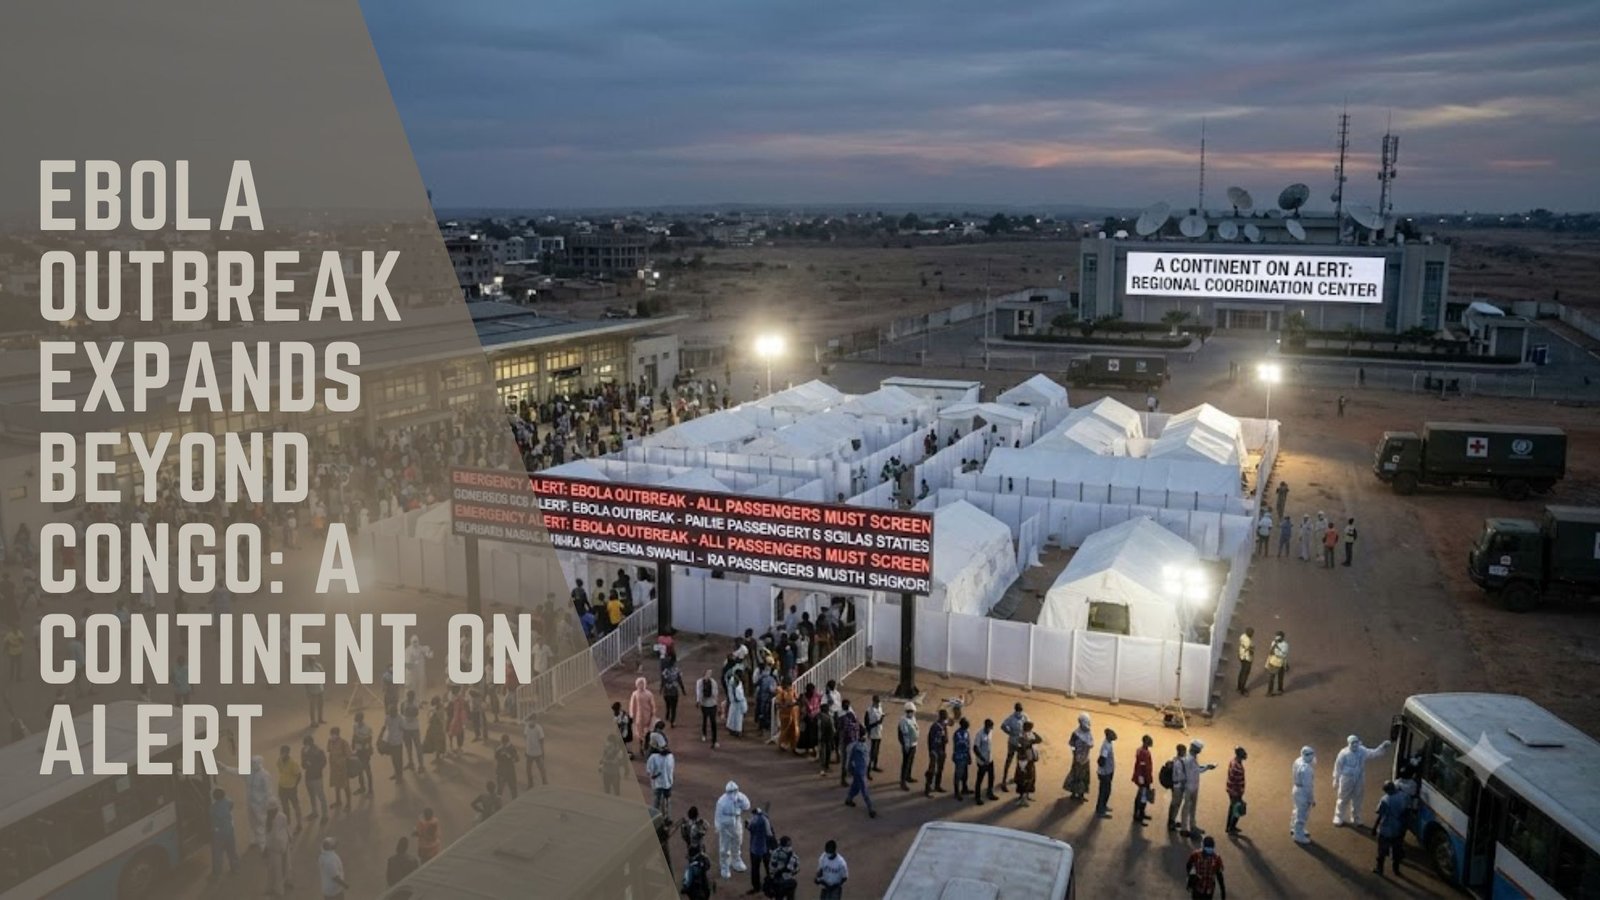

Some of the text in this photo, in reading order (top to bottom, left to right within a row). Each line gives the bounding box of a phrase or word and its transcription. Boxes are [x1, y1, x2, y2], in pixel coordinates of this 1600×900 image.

[1154, 258, 1353, 278] A CONTINENT ON ALERT:
[1131, 276, 1377, 297] REGIONAL COORDINATION CENTER
[453, 471, 524, 491] EMERGENCY
[527, 478, 568, 495] ALERT:
[571, 484, 612, 499] EBOLA
[615, 488, 686, 508] OUTBREAK
[697, 497, 723, 511] ALL
[725, 499, 821, 522] PASSENGERS
[825, 510, 866, 527] MUST
[870, 515, 930, 533] SCREEN
[573, 502, 612, 517] EBOLA
[612, 507, 675, 524] OUTBREAK
[455, 505, 527, 524] EMERGENCY
[528, 514, 571, 531] ALERT:
[573, 519, 615, 535] EBOLA
[617, 524, 688, 544] OUTBREAK
[699, 534, 725, 549] ALL
[728, 537, 821, 560] PASSENGERS
[825, 548, 867, 565] MUST
[870, 554, 929, 573] SCREEN
[728, 555, 814, 578] PASSENGERS
[817, 566, 865, 584] MUSTH
